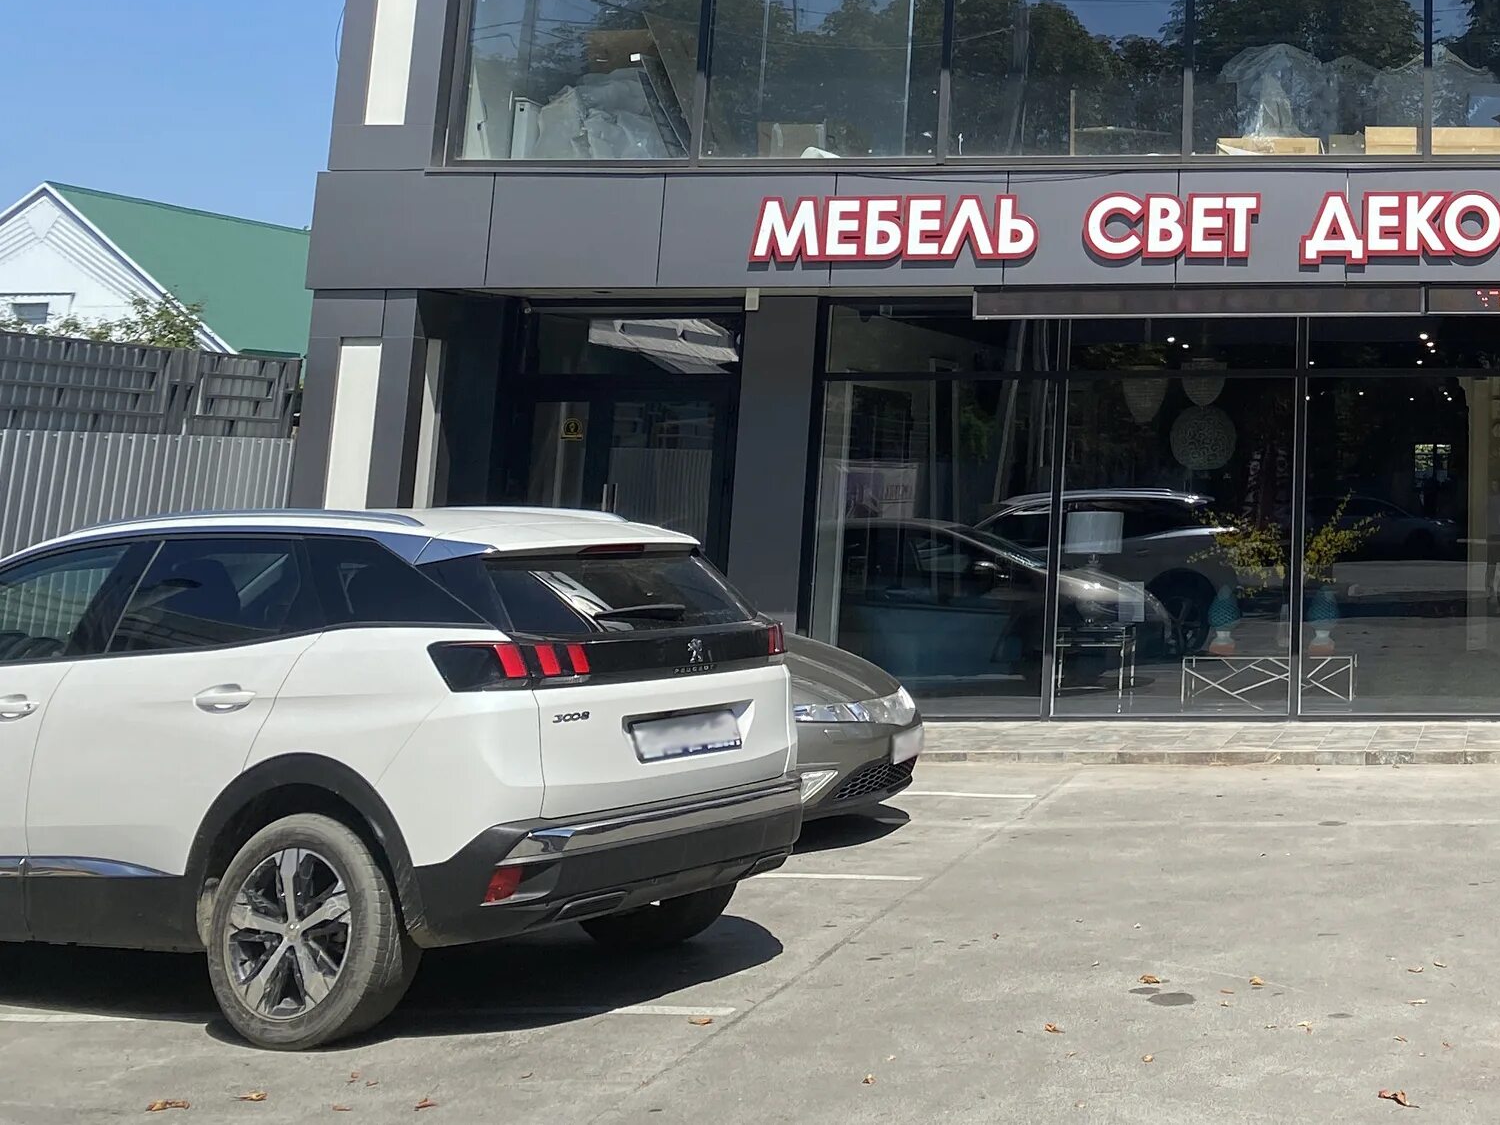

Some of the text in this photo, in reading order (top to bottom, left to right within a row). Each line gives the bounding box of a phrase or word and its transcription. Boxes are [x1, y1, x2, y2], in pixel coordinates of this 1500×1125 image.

[749, 194, 1039, 262] МЕБЕЛЬ
[1082, 192, 1261, 259] СВЕТ
[552, 711, 590, 724] 3008
